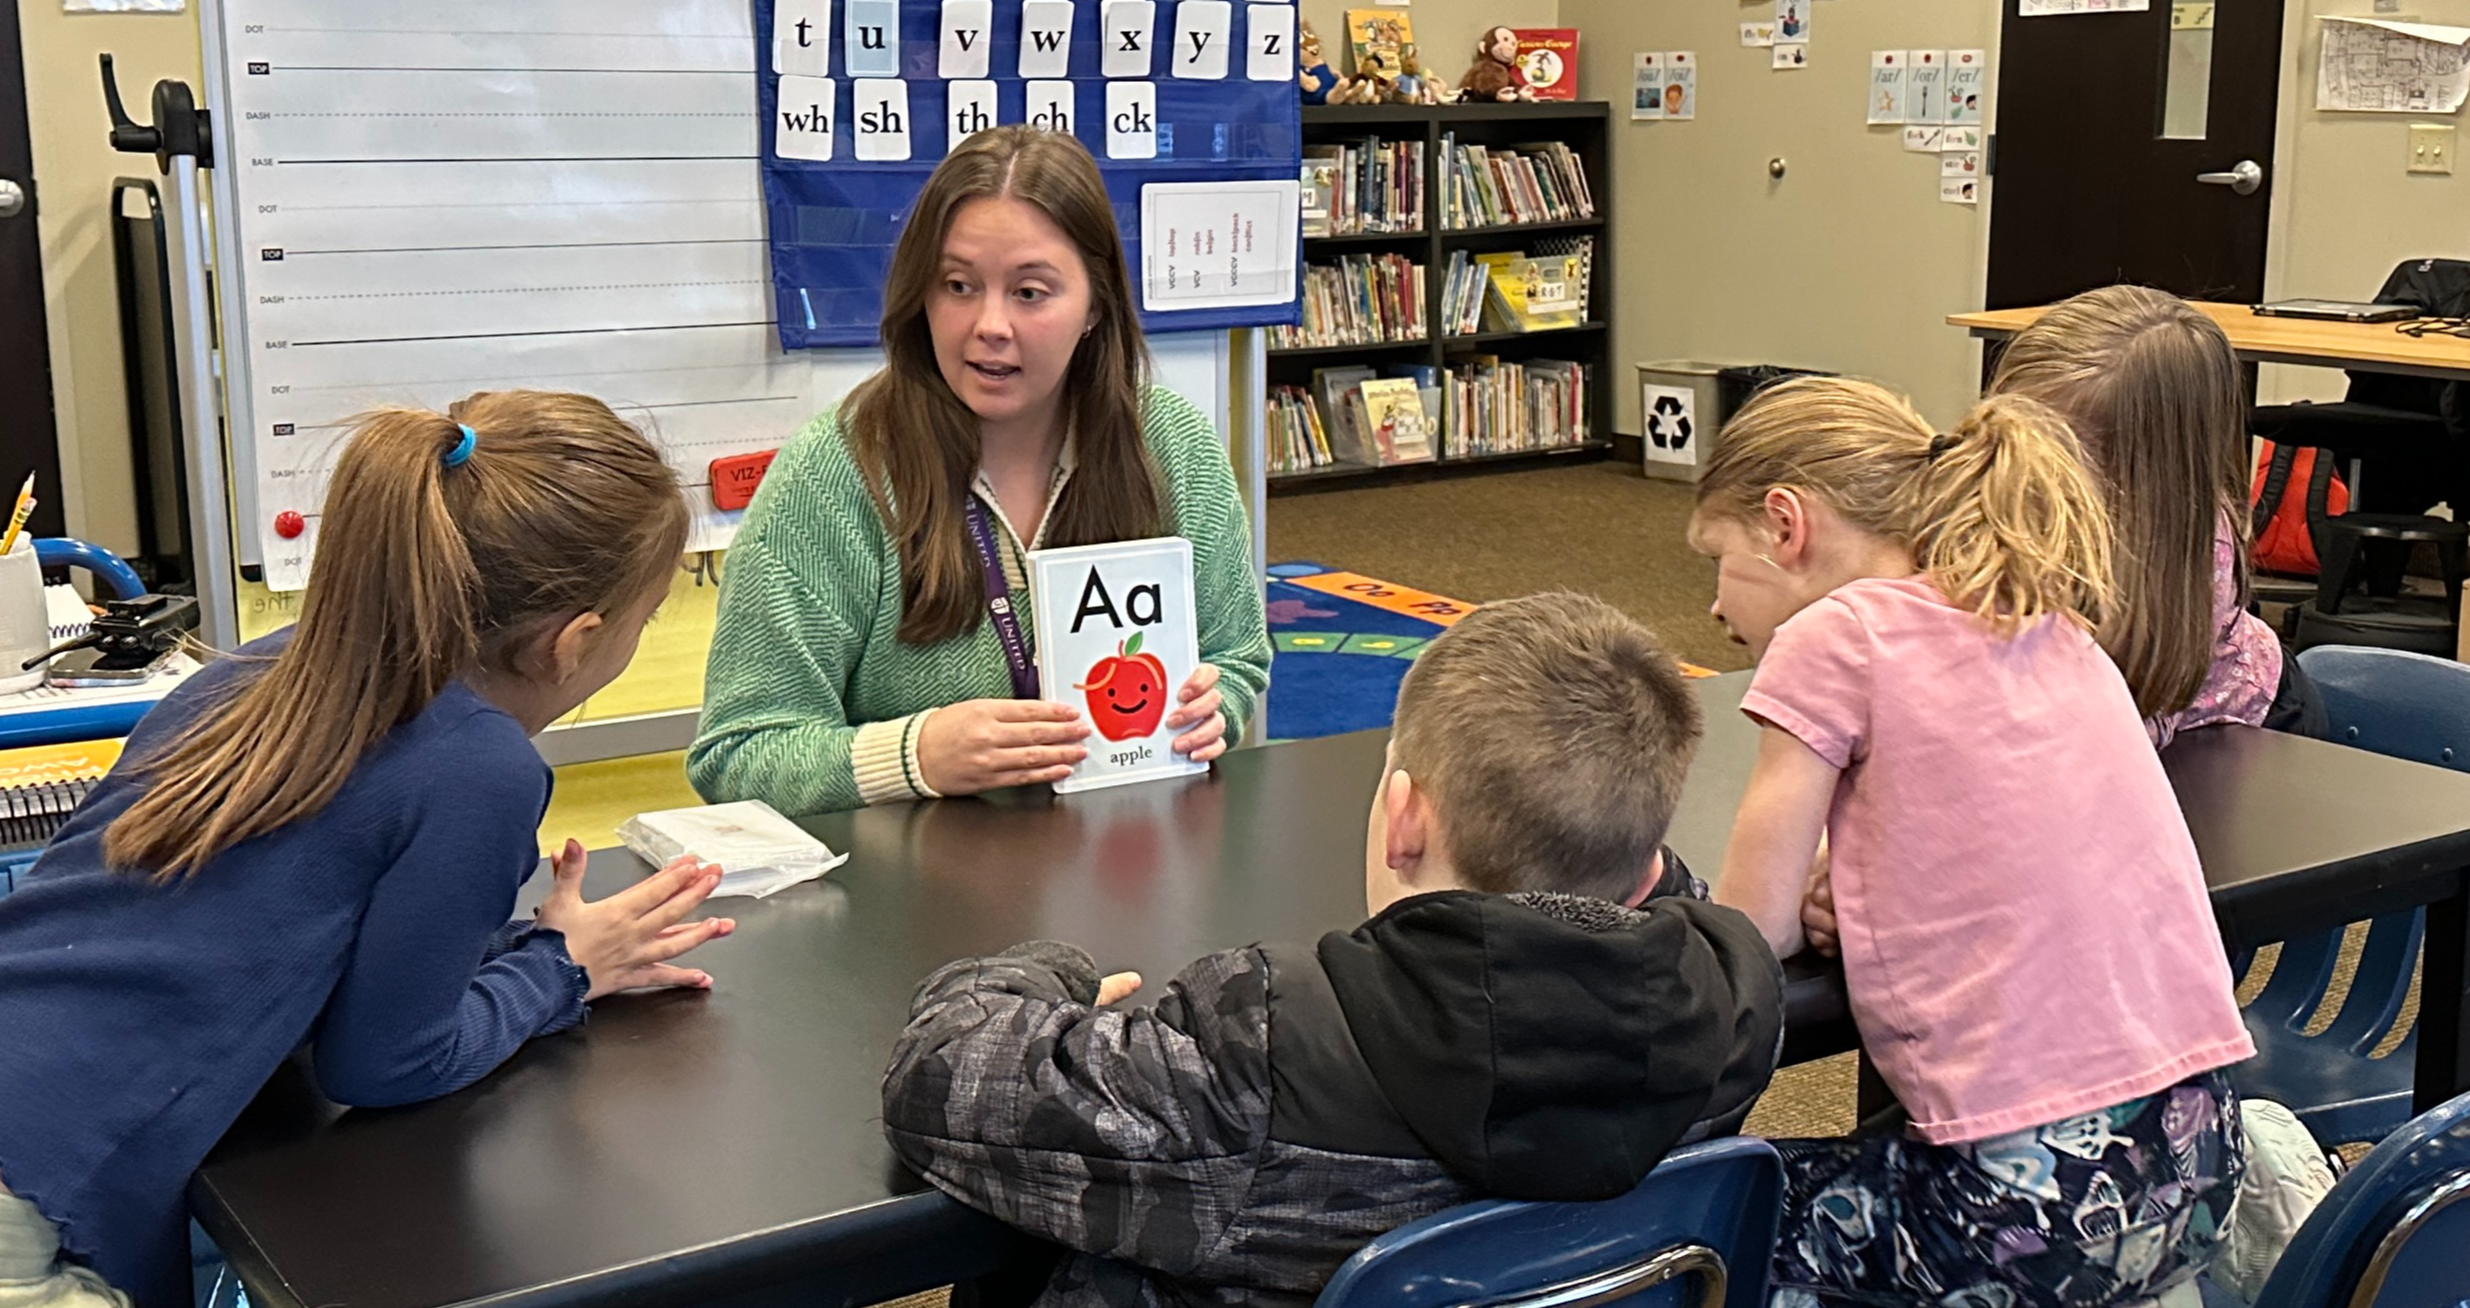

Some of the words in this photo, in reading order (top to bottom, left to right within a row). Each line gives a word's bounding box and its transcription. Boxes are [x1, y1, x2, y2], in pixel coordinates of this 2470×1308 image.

[245, 25, 264, 34] DOT
[795, 17, 813, 48] t
[858, 26, 886, 49] u
[955, 29, 979, 52] v
[1031, 31, 1065, 52] w
[1119, 30, 1142, 51] x
[1188, 31, 1211, 64] y
[1263, 34, 1281, 55] z
[250, 65, 268, 73] TOP
[246, 112, 271, 120] DASH
[782, 104, 829, 133] wh
[860, 100, 903, 133] sh
[956, 101, 989, 134] th
[1032, 102, 1070, 133] ch
[1114, 102, 1152, 133] ck
[252, 158, 274, 167] BASE
[259, 205, 278, 213] DOT
[263, 251, 282, 259] TOP
[260, 296, 285, 305] DASH
[265, 341, 288, 349] BASE
[271, 386, 291, 394] DOT
[275, 425, 293, 434] TOP
[271, 470, 296, 479] DASH
[1070, 563, 1163, 634] Aa
[1001, 617, 1026, 671] UNITED
[1110, 745, 1153, 766] apple
